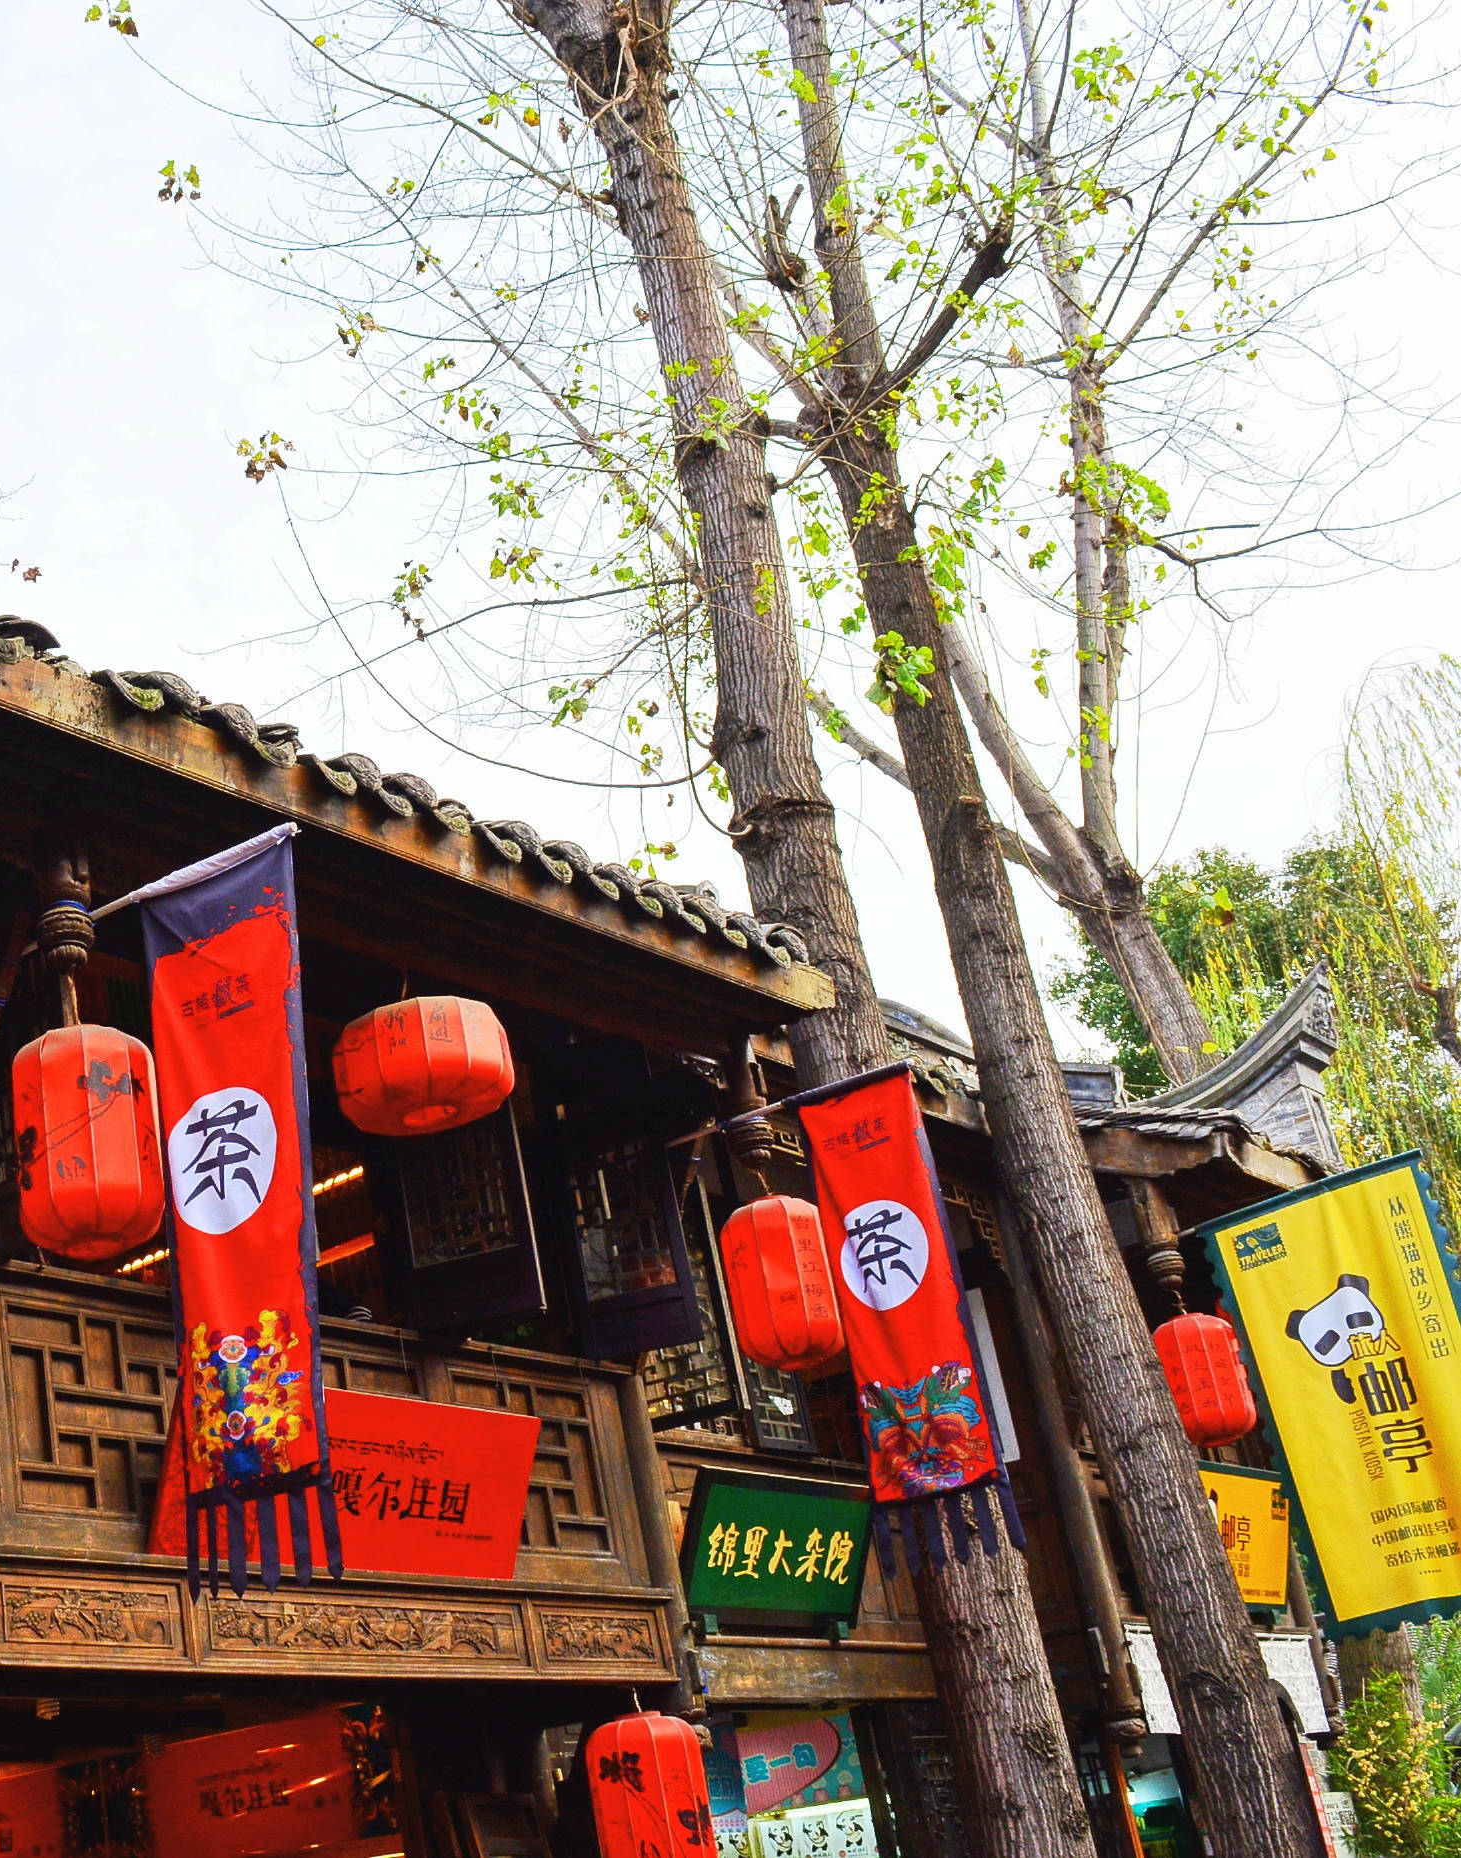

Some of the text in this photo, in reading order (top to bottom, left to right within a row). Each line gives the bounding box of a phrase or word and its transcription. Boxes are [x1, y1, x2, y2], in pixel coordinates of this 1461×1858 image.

[183, 1099, 261, 1206] 茶
[848, 1208, 920, 1294] 茶
[1240, 1244, 1285, 1265] TRAVELER
[1388, 1196, 1450, 1359] 从熊猫故乡寄出
[1347, 1329, 1402, 1361] 旅人
[1349, 1410, 1384, 1482] POSTAL KIOSK
[1359, 1356, 1434, 1473] 邮亭
[1221, 1512, 1251, 1551] 邮亭
[1371, 1497, 1448, 1525] 国内国际邮寄
[1371, 1517, 1460, 1549] 中国邮政挂号信
[707, 1521, 854, 1585] 锦里大杂院
